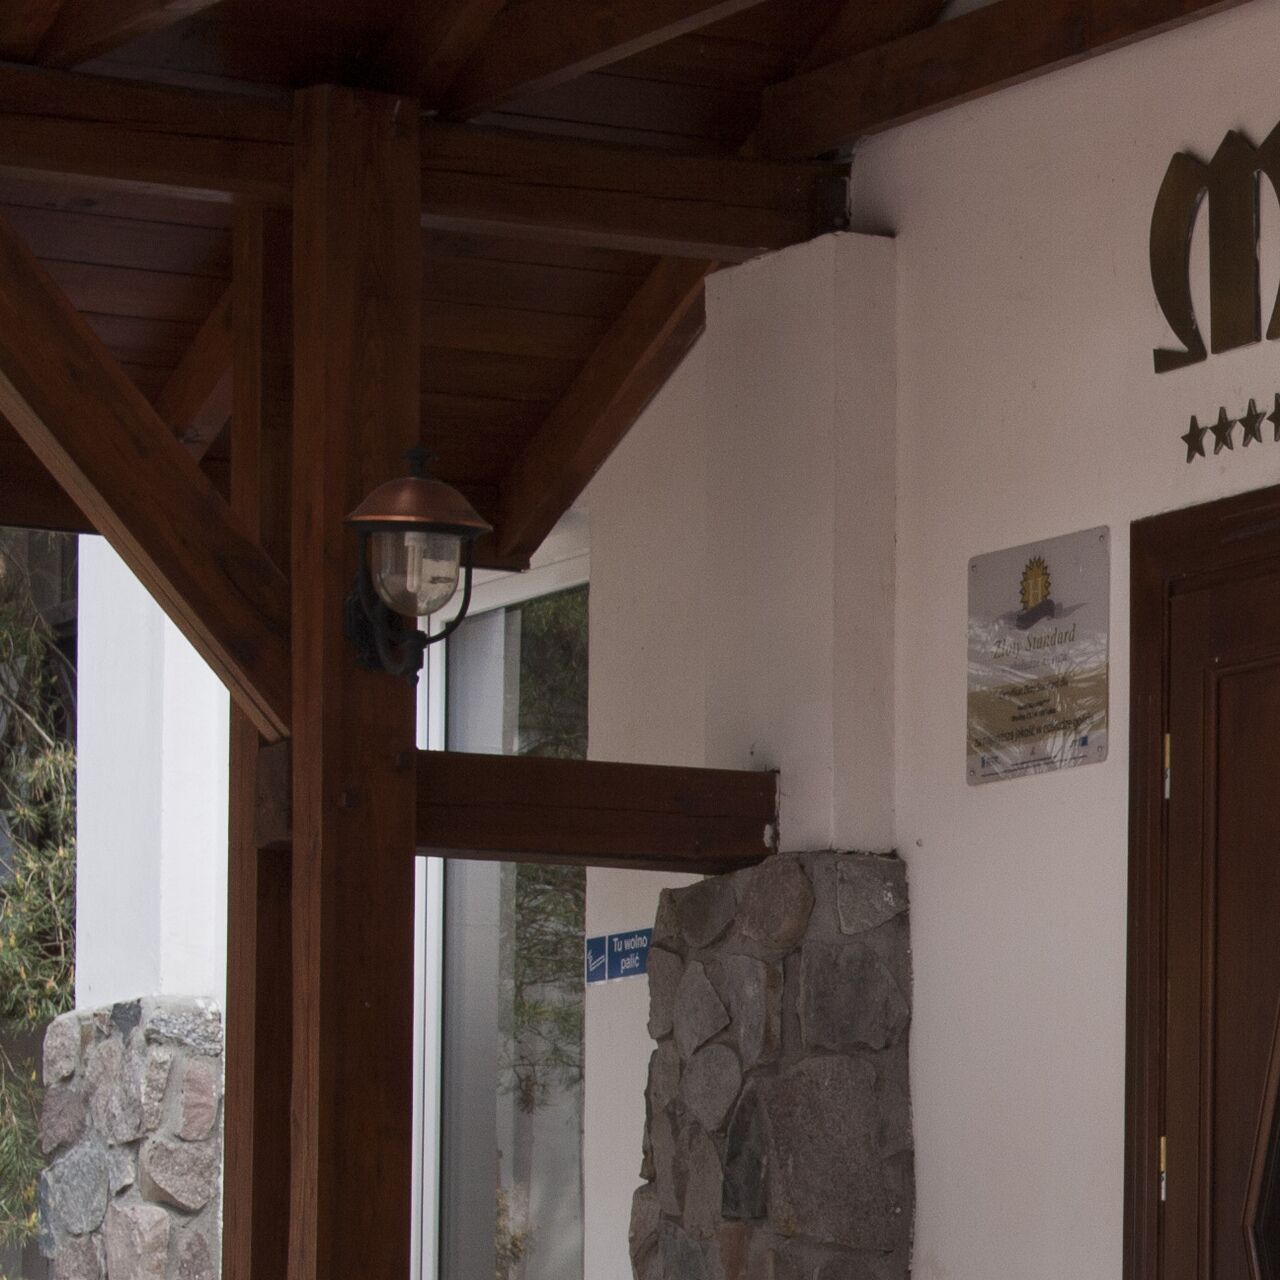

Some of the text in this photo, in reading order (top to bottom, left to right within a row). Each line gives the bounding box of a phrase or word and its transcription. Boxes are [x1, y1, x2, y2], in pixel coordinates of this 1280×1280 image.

[1025, 622, 1076, 653] Standard
[612, 934, 648, 953] Tu wolno
[620, 951, 640, 974] palić
